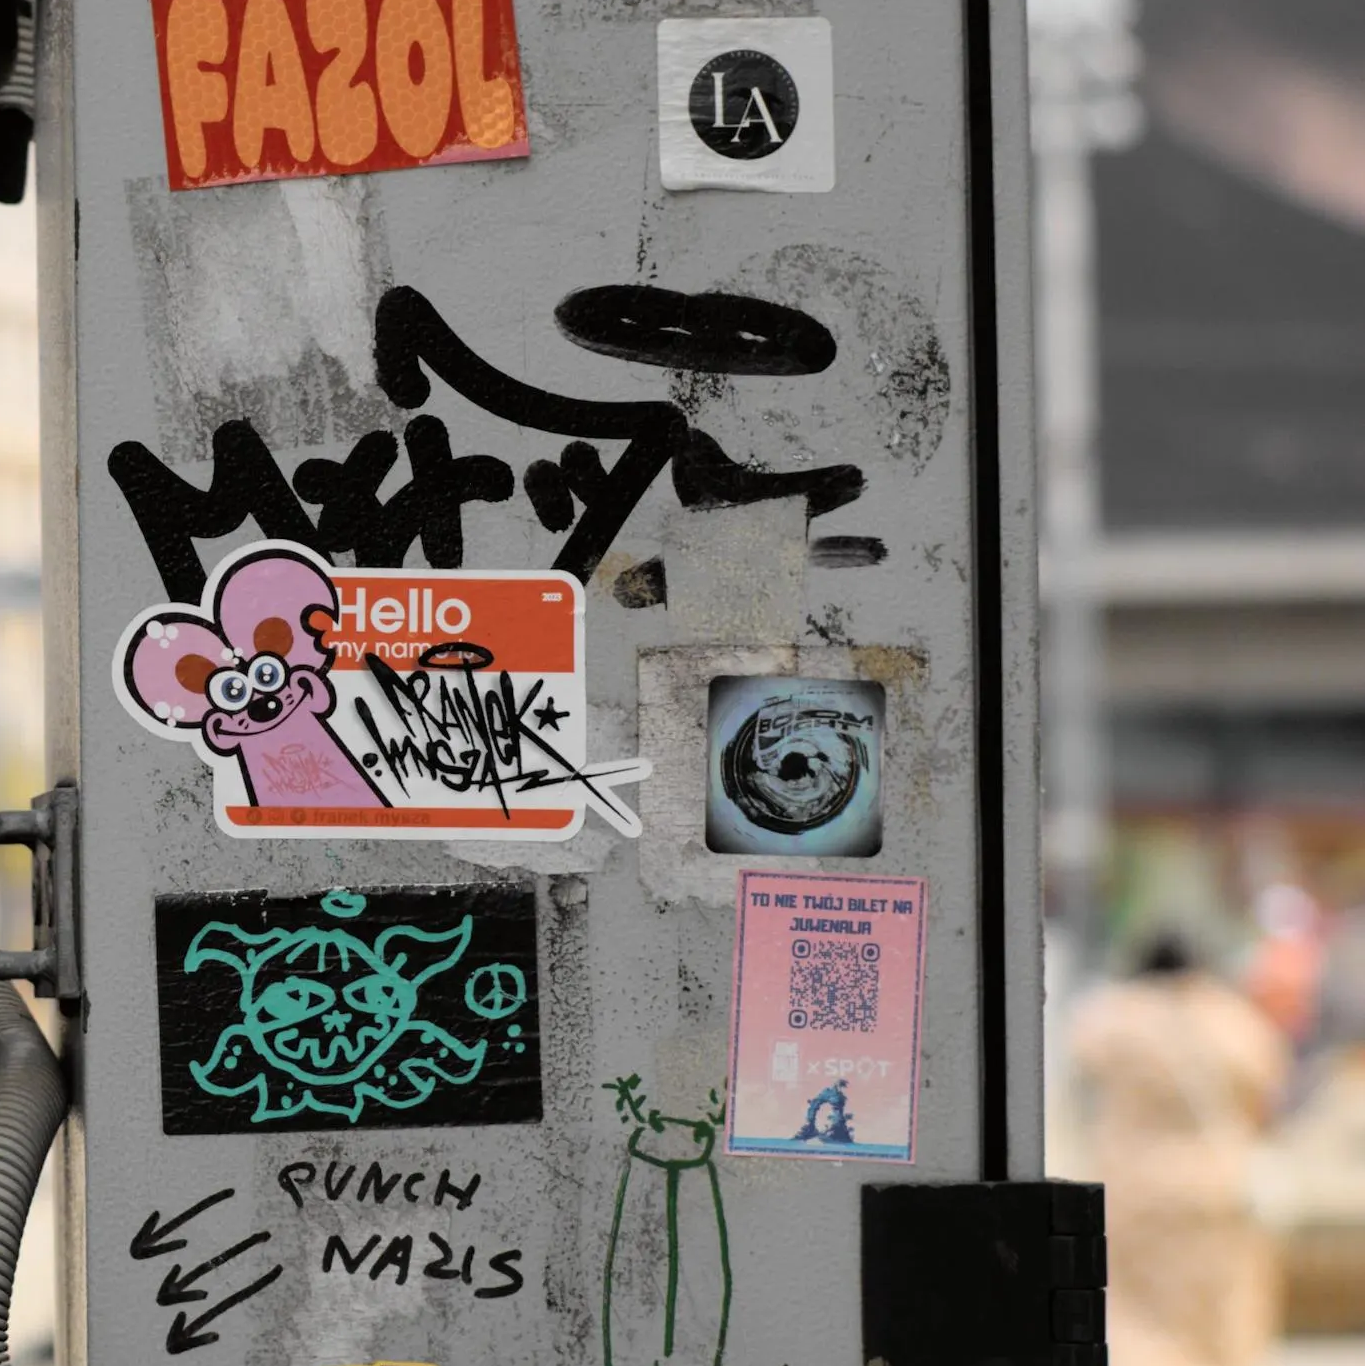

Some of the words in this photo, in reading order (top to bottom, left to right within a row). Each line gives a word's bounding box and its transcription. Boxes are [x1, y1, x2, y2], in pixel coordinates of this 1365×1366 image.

[711, 72, 783, 143] LA
[332, 587, 472, 634] Hello
[329, 641, 367, 663] my
[751, 892, 769, 907] TO
[775, 894, 797, 909] NIE
[803, 893, 843, 911] TWÓJ
[848, 898, 888, 913] BILET
[893, 900, 913, 915] NA
[789, 917, 872, 935] JUWENALIA
[278, 1159, 481, 1211] PUNCH
[321, 1231, 524, 1298] NAZIS
